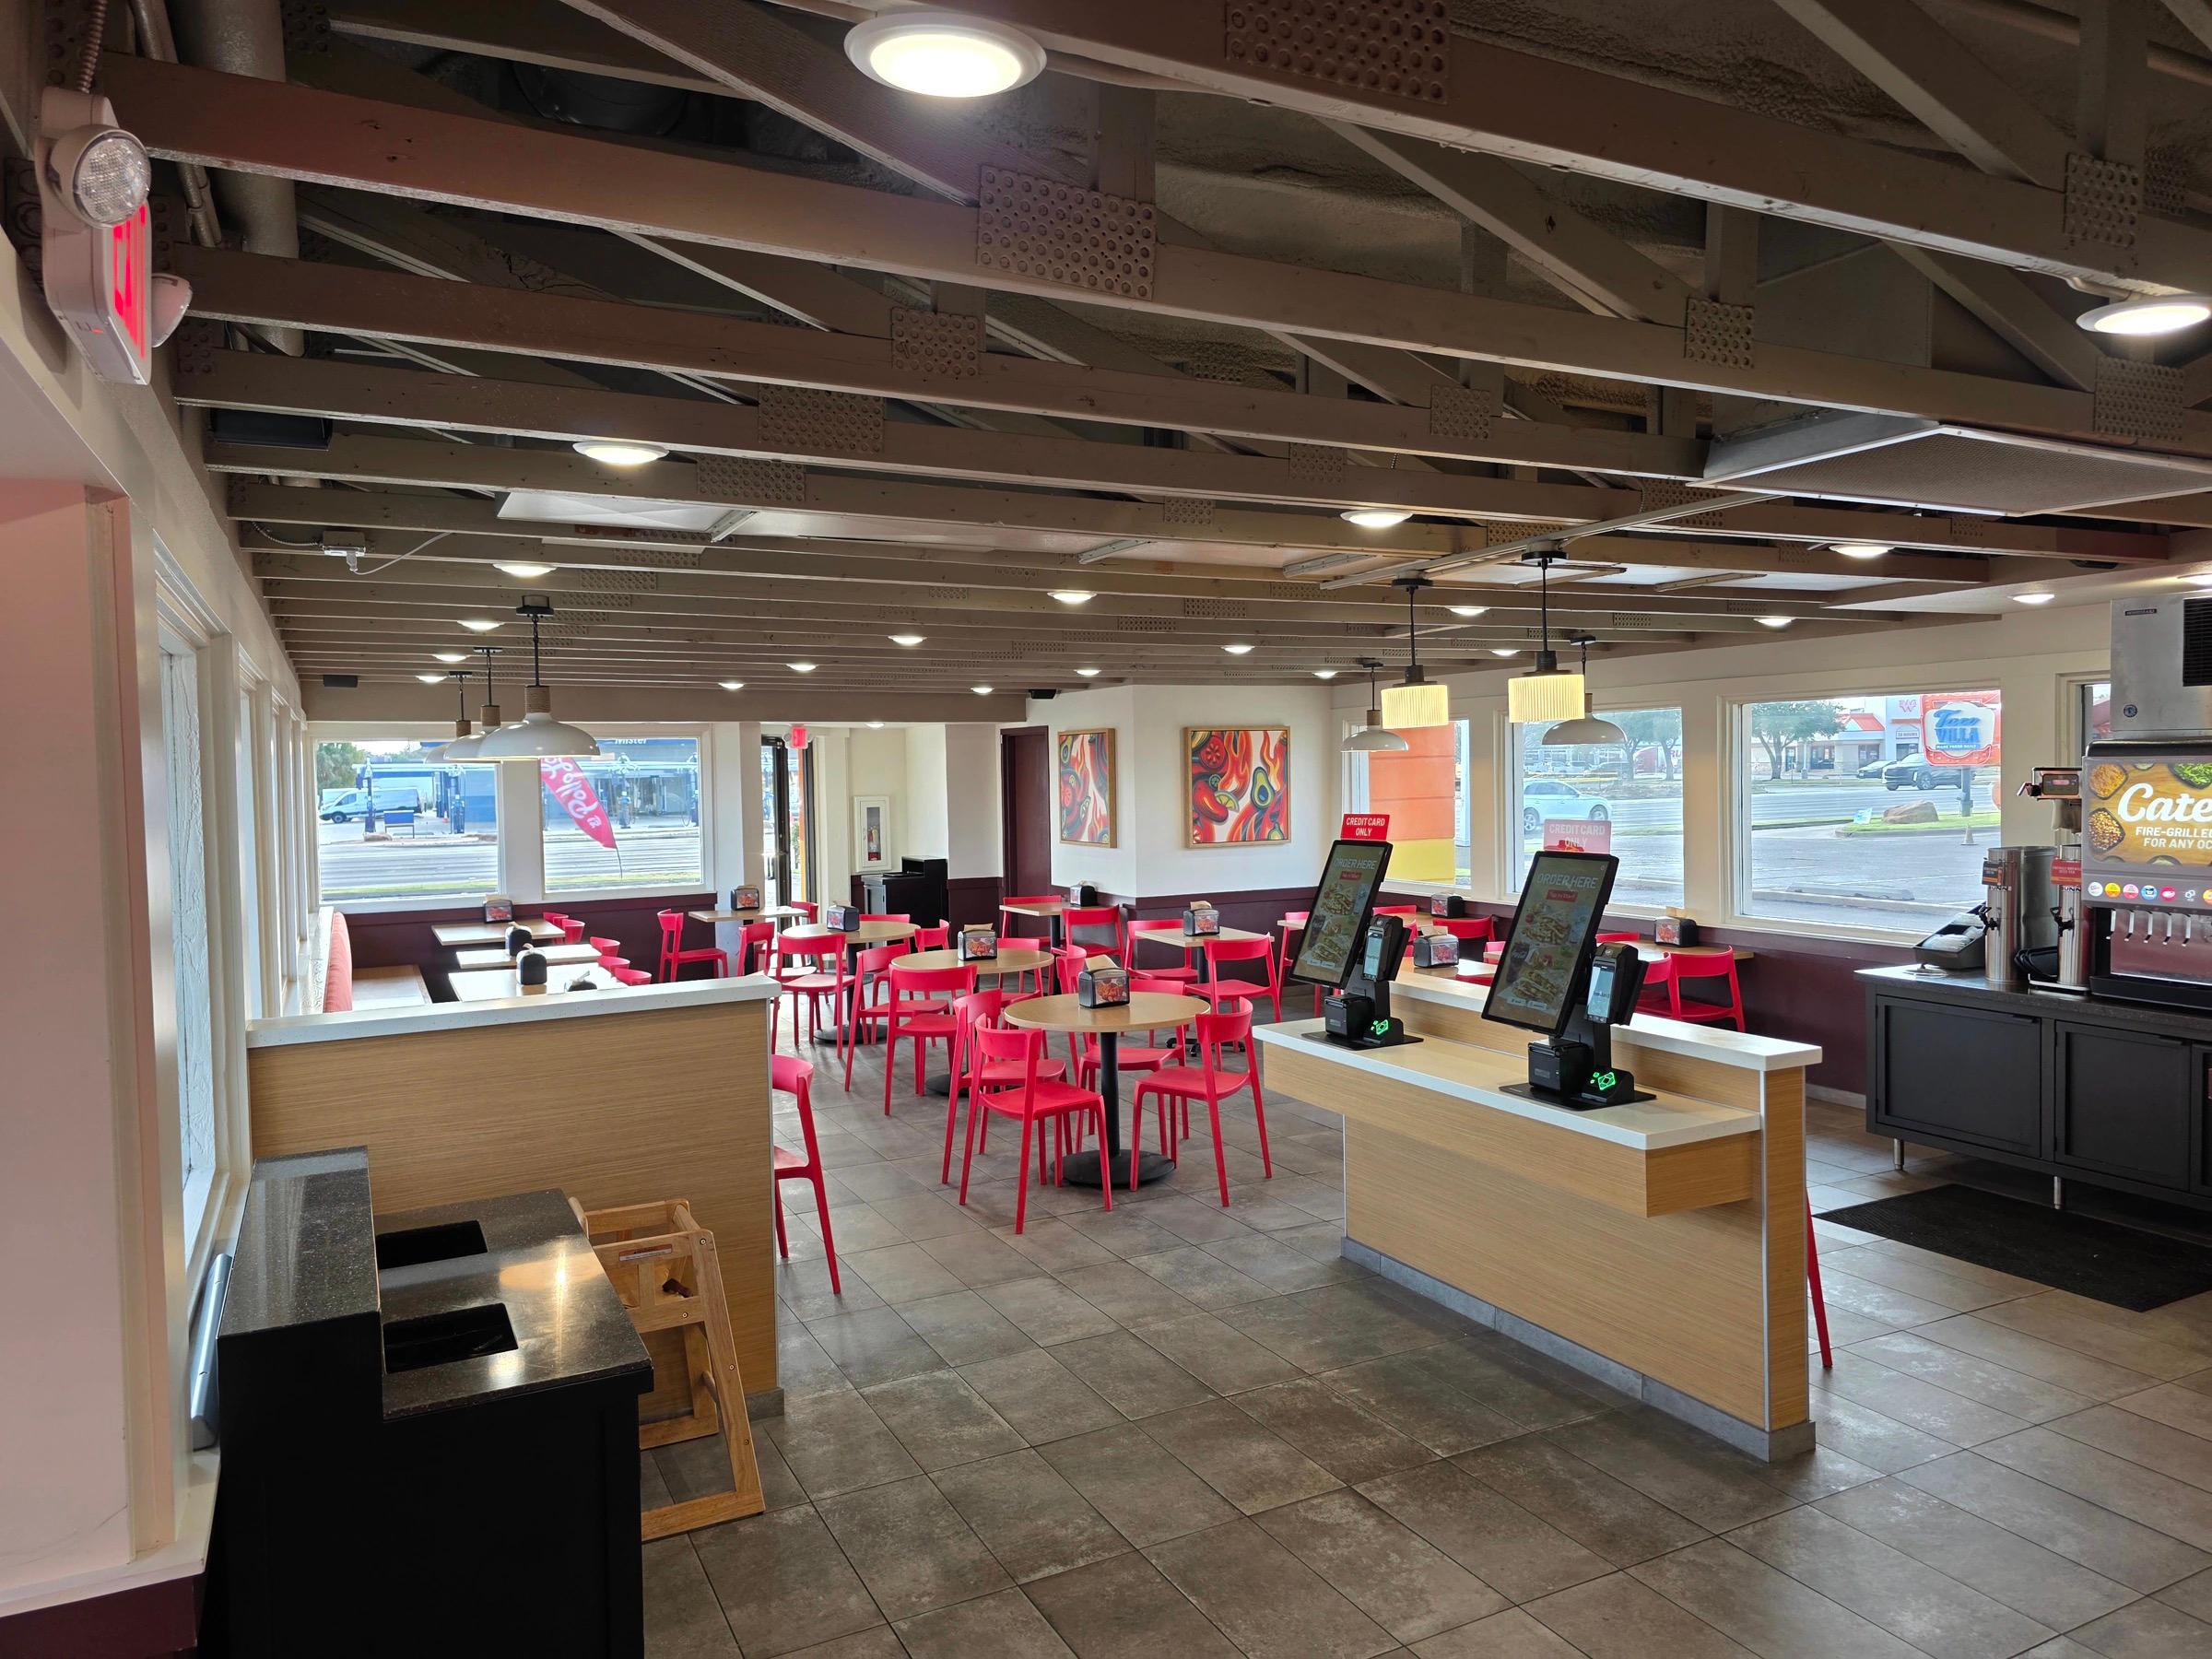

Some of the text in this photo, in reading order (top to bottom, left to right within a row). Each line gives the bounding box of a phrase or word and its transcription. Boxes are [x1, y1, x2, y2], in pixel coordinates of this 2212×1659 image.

[1935, 728, 1980, 743] VILLA
[556, 772, 598, 818] Pollo
[1347, 818, 1368, 826] CREDIT
[1356, 828, 1372, 836] ONLY
[1549, 825, 1605, 835] CREDIT CARD
[1565, 837, 1588, 846] ONLY
[2144, 838, 2167, 848] FOR
[2170, 840, 2194, 849] ANY
[1334, 858, 1377, 870] ORDER HERE
[1536, 874, 1598, 888] ORDER HERE
